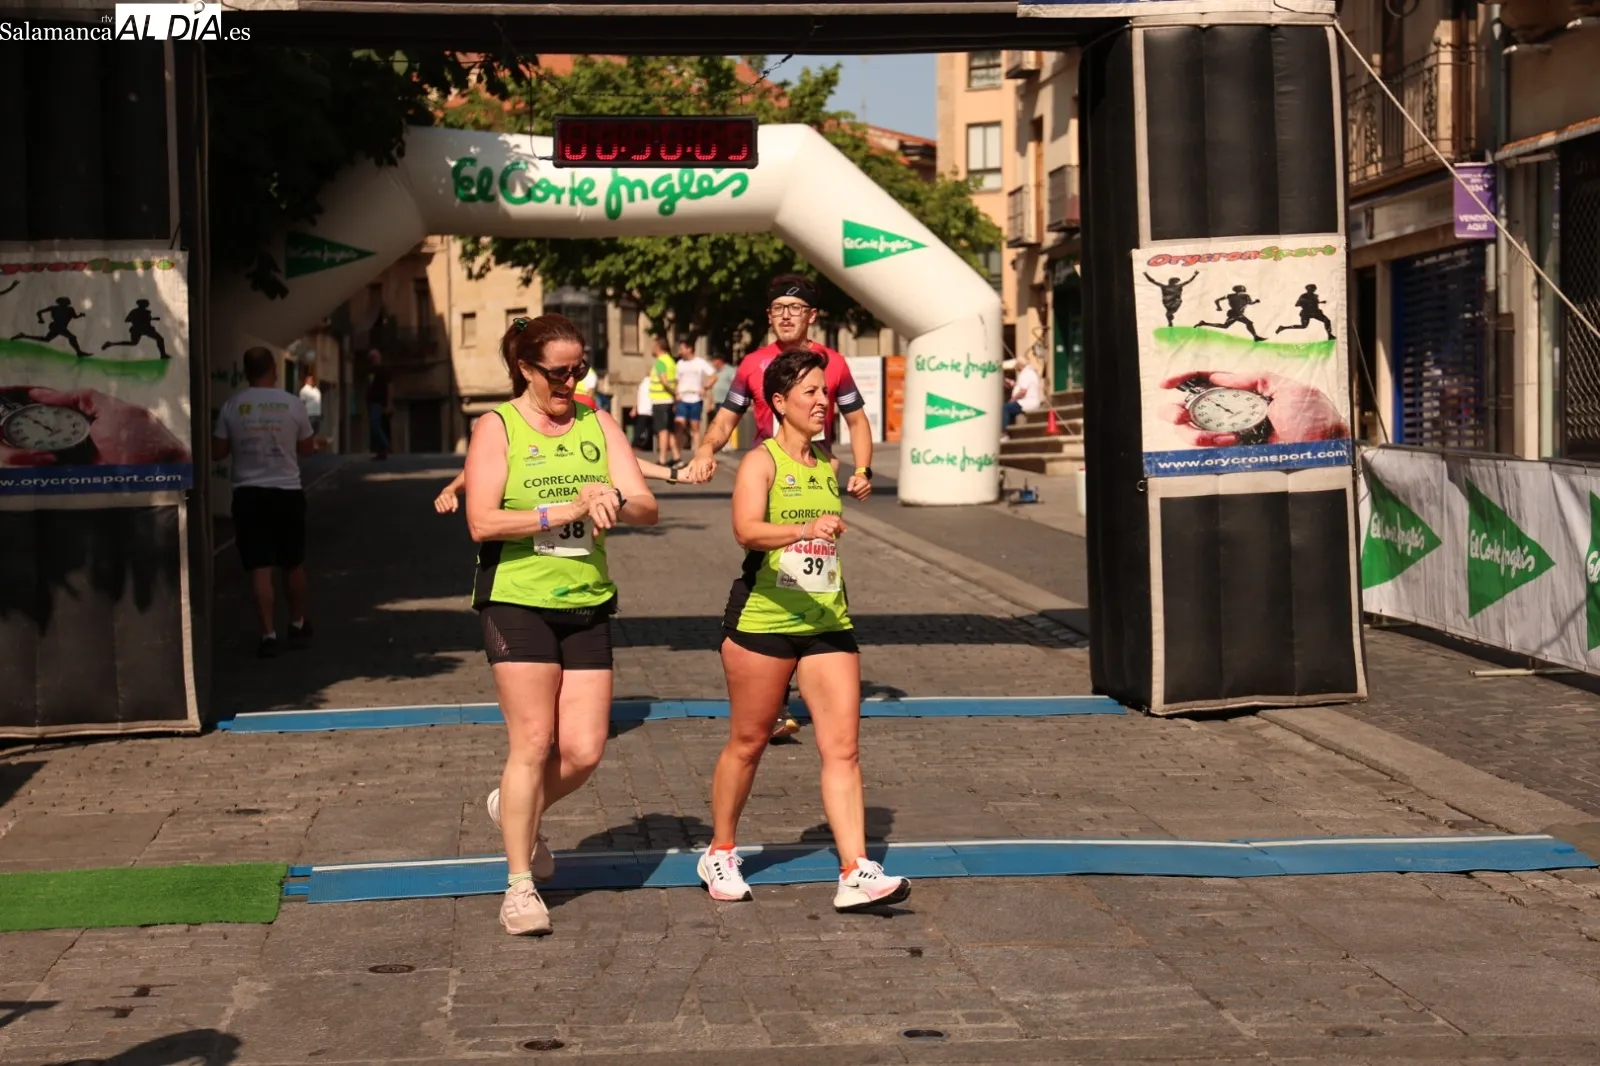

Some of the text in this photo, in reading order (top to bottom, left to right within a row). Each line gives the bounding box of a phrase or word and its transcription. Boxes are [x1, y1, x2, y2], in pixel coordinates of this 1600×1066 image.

[452, 156, 496, 203] El
[499, 160, 598, 206] Corte
[1157, 449, 1347, 470] www.orycronsport.com
[523, 474, 609, 489] CORRECAMINOS
[558, 520, 585, 540] 38
[1469, 529, 1480, 559] El
[1479, 532, 1501, 565] Corte
[803, 557, 824, 576] 39
